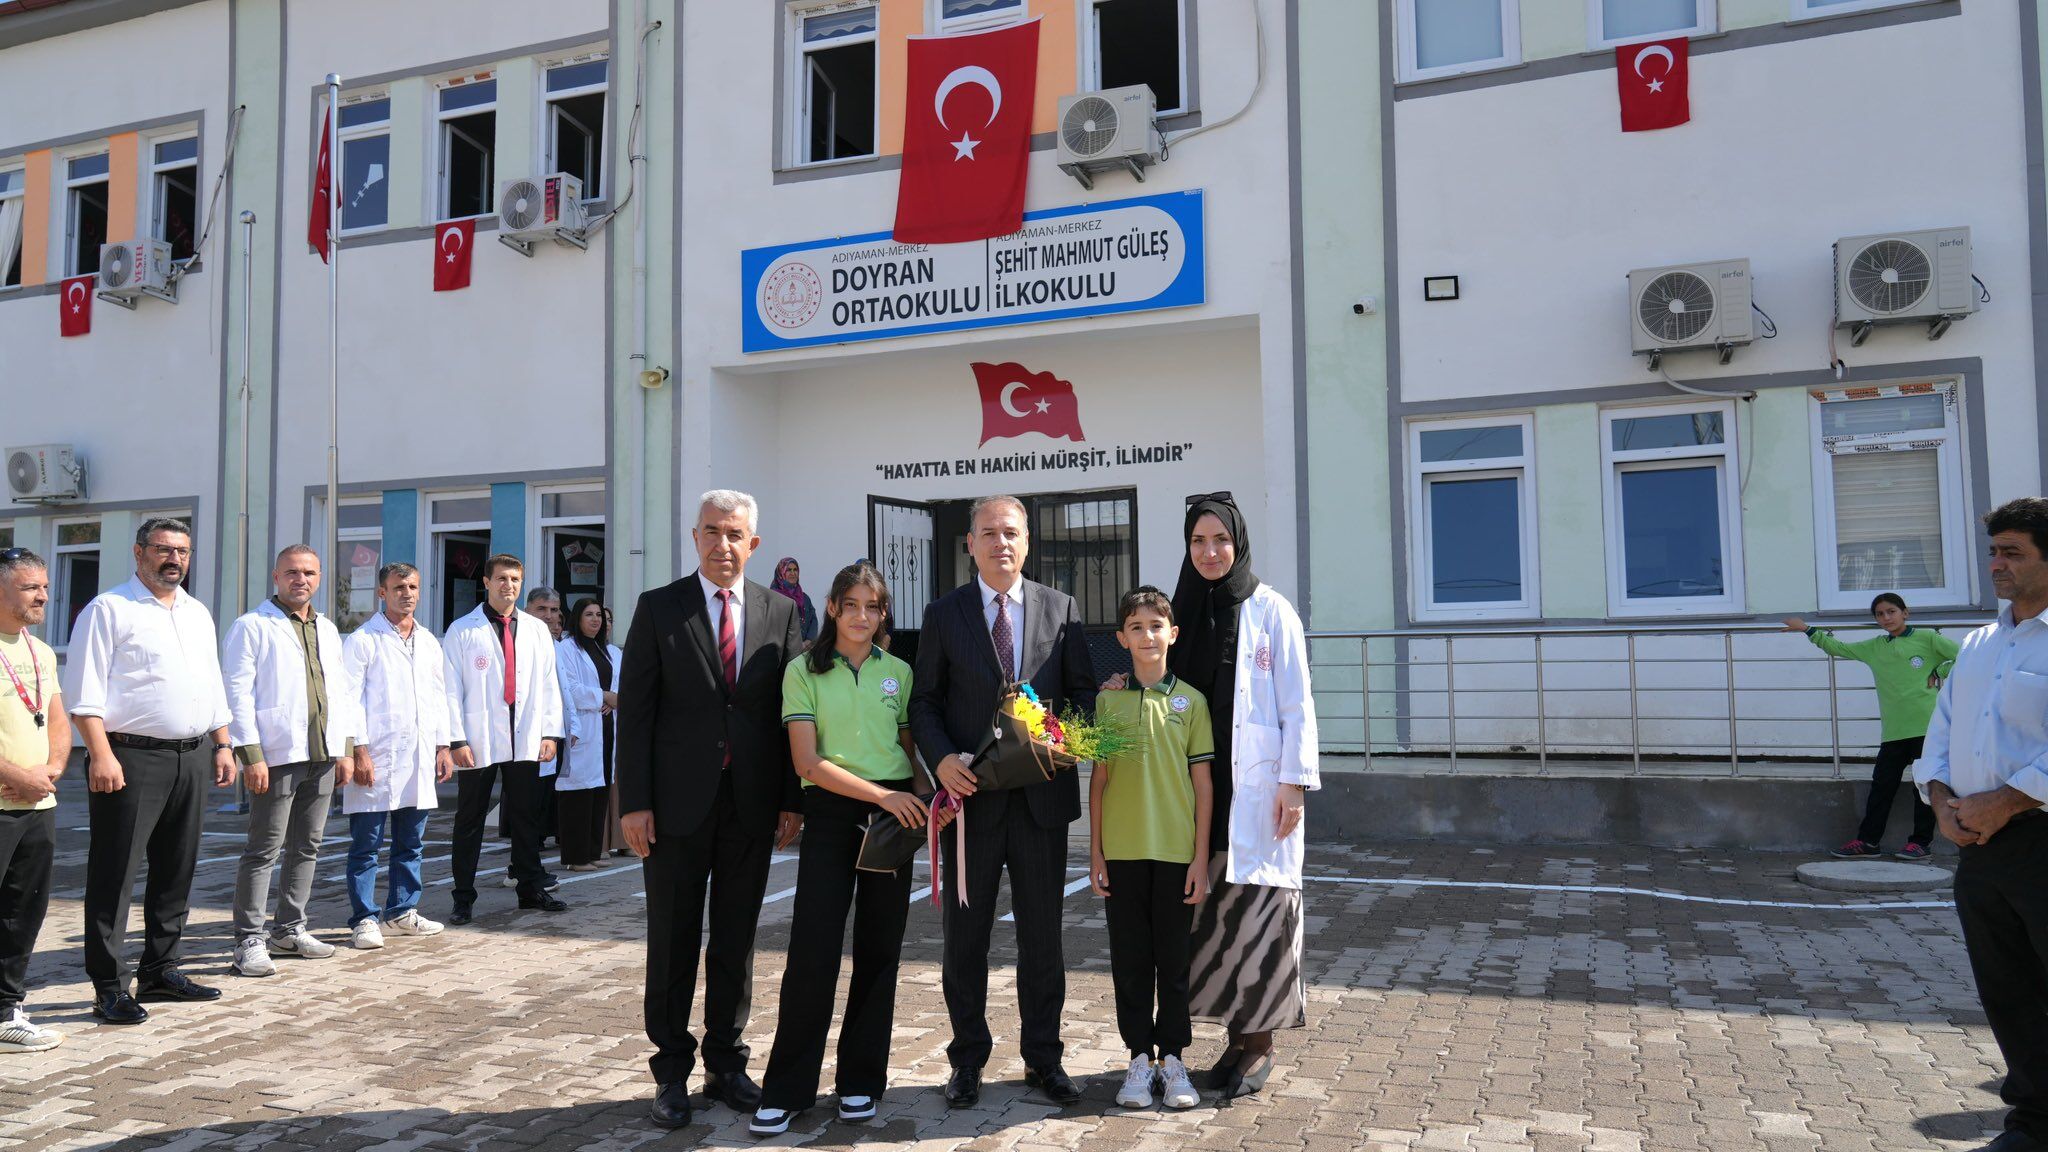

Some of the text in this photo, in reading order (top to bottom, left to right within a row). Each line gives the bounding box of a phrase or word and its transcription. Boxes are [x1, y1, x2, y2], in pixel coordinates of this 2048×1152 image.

[832, 243, 928, 263] ADIYAMAN-MERKEZ
[995, 227, 1169, 280] ŞEHİT MAHMUT GÜLEŞ
[1939, 238, 1964, 247] airfel
[134, 245, 144, 283] VESTEL
[832, 257, 934, 293] DOYRAN
[1721, 270, 1744, 278] airfel
[832, 286, 980, 326] ORTAOKULU
[955, 459, 976, 475] EN
[981, 451, 1036, 473] HAKİKİ
[1041, 446, 1111, 472] MÜRŞİT,
